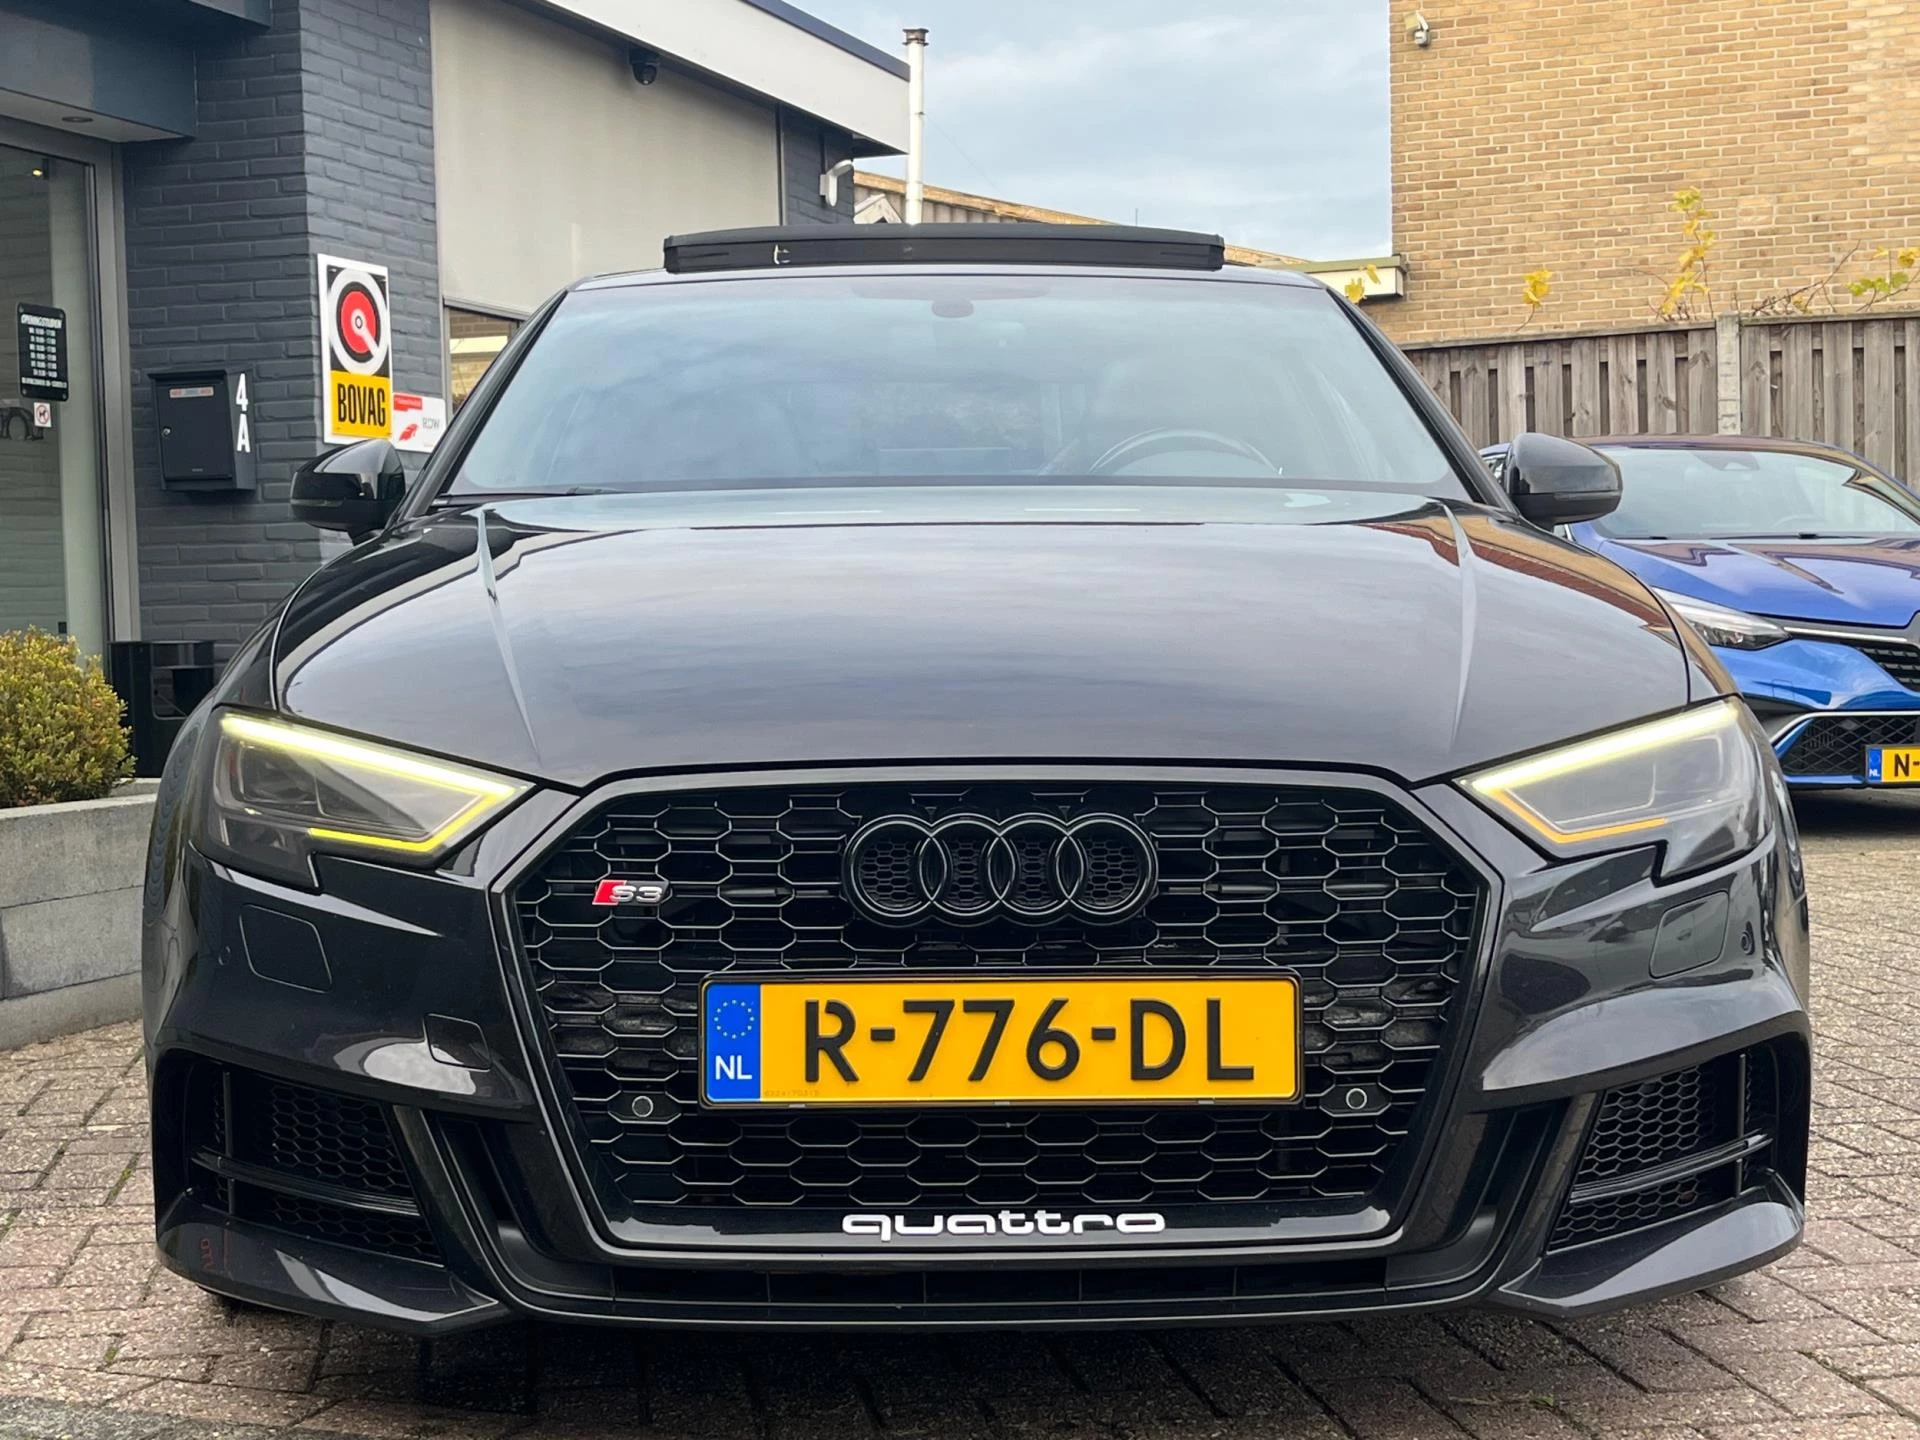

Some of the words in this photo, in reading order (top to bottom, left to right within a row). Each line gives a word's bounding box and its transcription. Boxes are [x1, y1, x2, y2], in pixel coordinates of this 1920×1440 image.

[337, 383, 386, 427] BOVAG
[1869, 768, 1880, 777] NL
[609, 885, 663, 902] S3
[805, 998, 1254, 1083] R-776-DL
[715, 1055, 753, 1080] NL
[842, 1209, 1165, 1241] quattro
